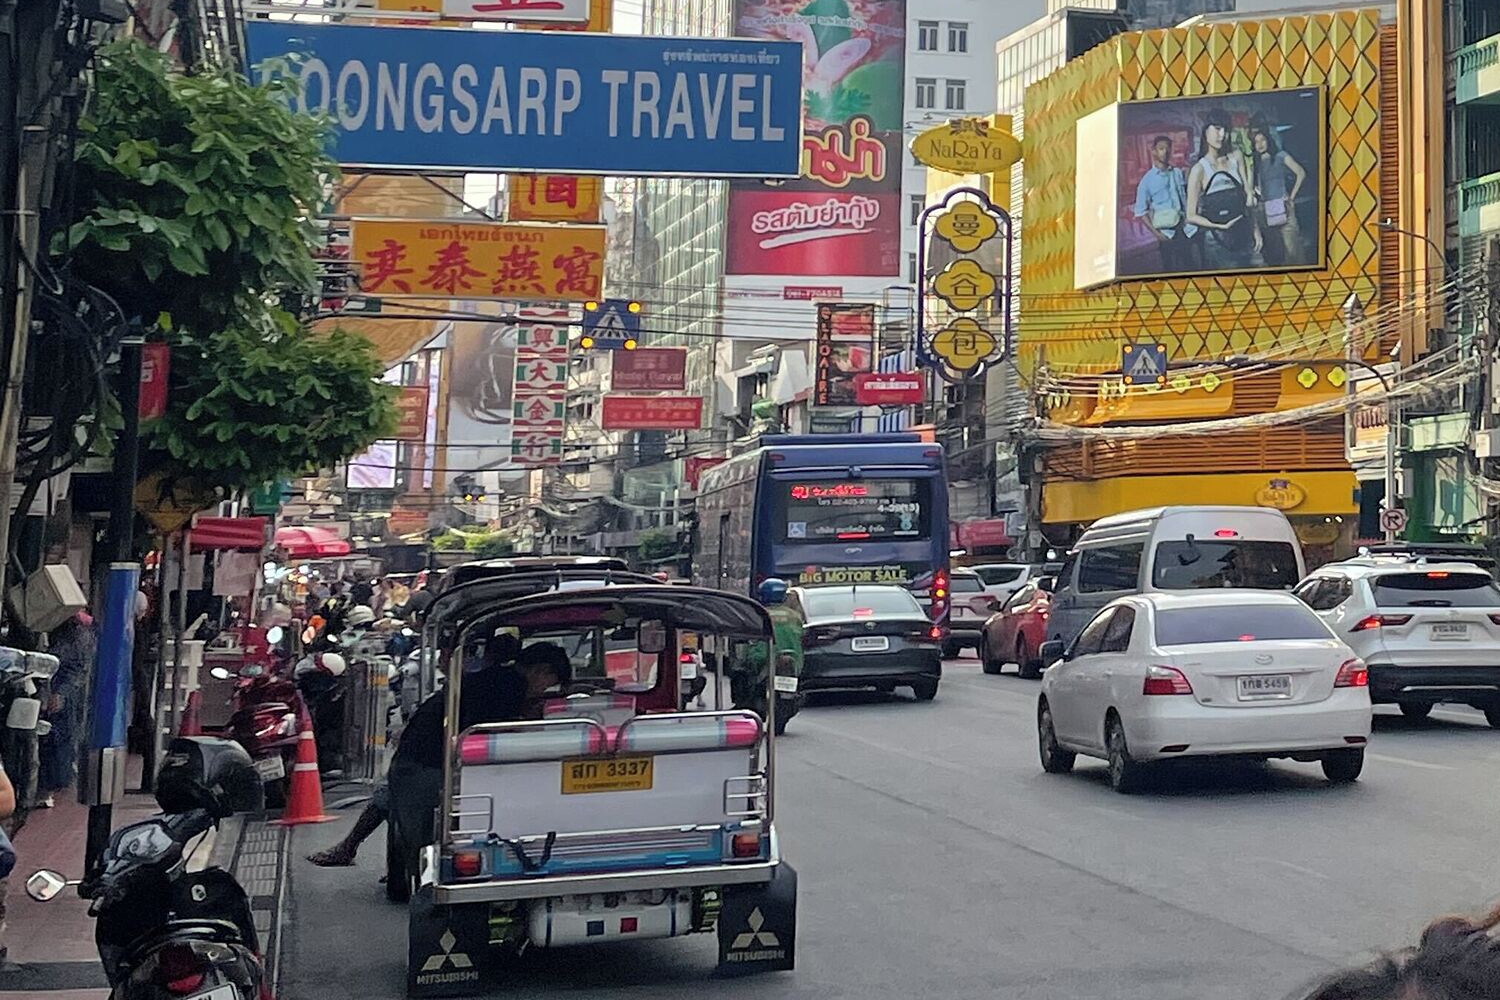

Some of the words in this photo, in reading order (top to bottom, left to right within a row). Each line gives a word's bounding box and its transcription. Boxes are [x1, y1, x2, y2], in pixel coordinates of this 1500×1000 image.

[601, 69, 785, 141] TRAVEL
[930, 139, 1002, 161] NaRaYa
[752, 196, 880, 233] รสต้มยำกุ้ง
[825, 571, 872, 583] MOTOR
[875, 570, 907, 581] SALE
[607, 760, 649, 777] 3337
[726, 948, 785, 962] MITSUBISHI
[417, 970, 479, 985] MITSUBISHI
